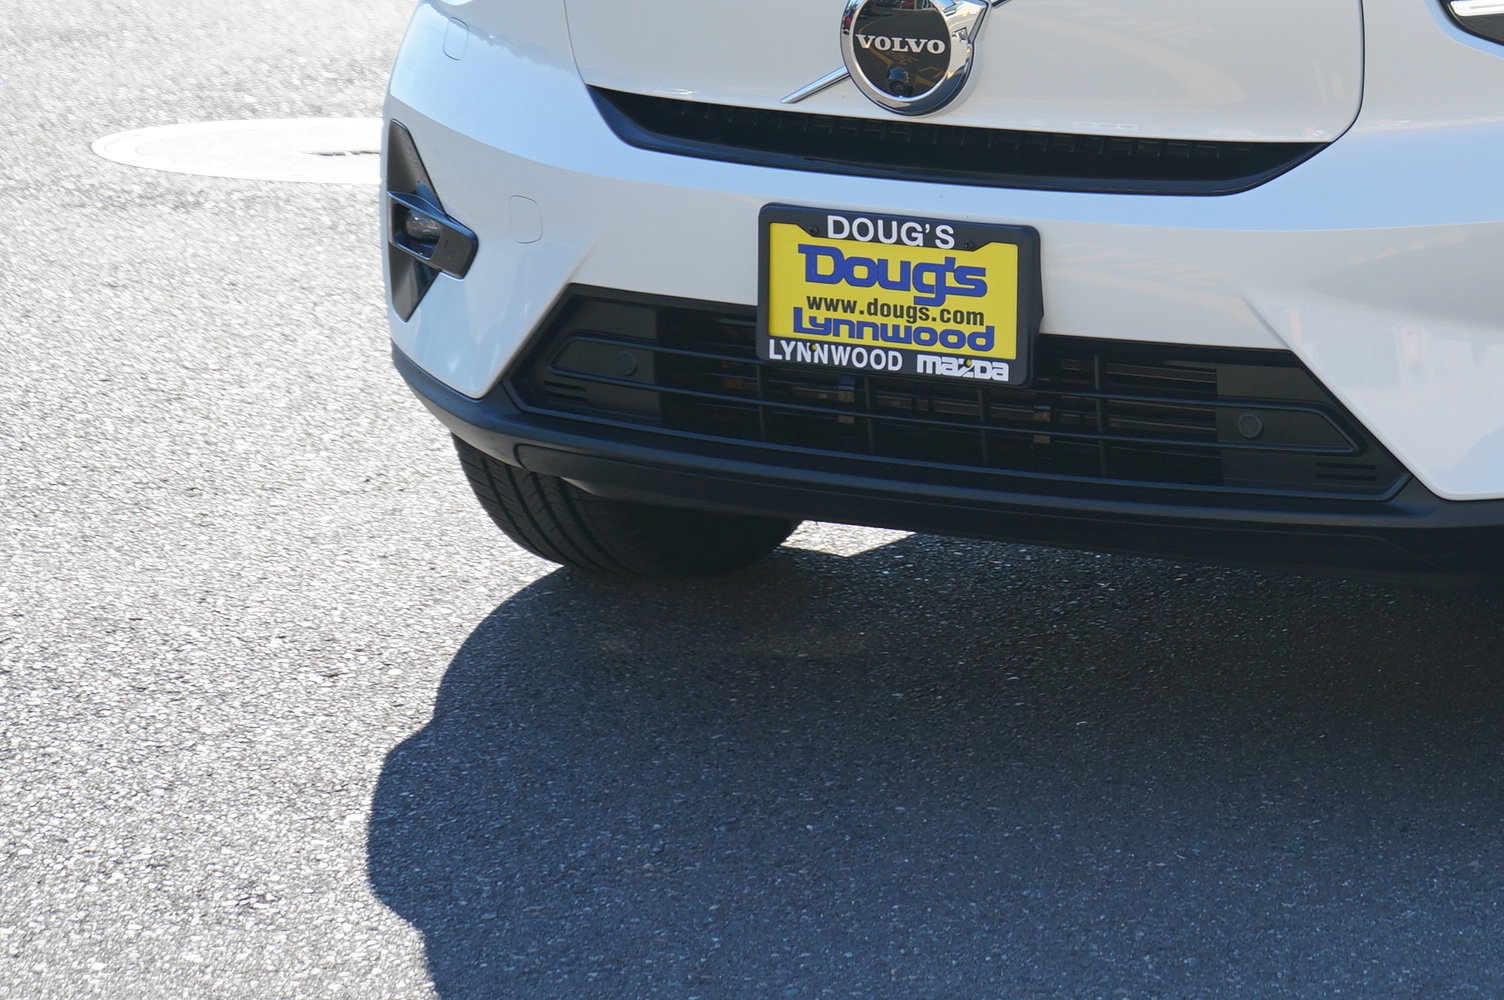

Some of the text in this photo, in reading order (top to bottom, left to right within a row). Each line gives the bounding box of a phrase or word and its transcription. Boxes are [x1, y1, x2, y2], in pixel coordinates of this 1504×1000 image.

[855, 33, 946, 55] VOLVO
[827, 215, 956, 249] DOUG'S
[798, 243, 988, 307] Doug's
[806, 296, 985, 326] www.dougs.com
[793, 307, 995, 352] Lynnwood
[769, 339, 903, 371] LYNNWOOD
